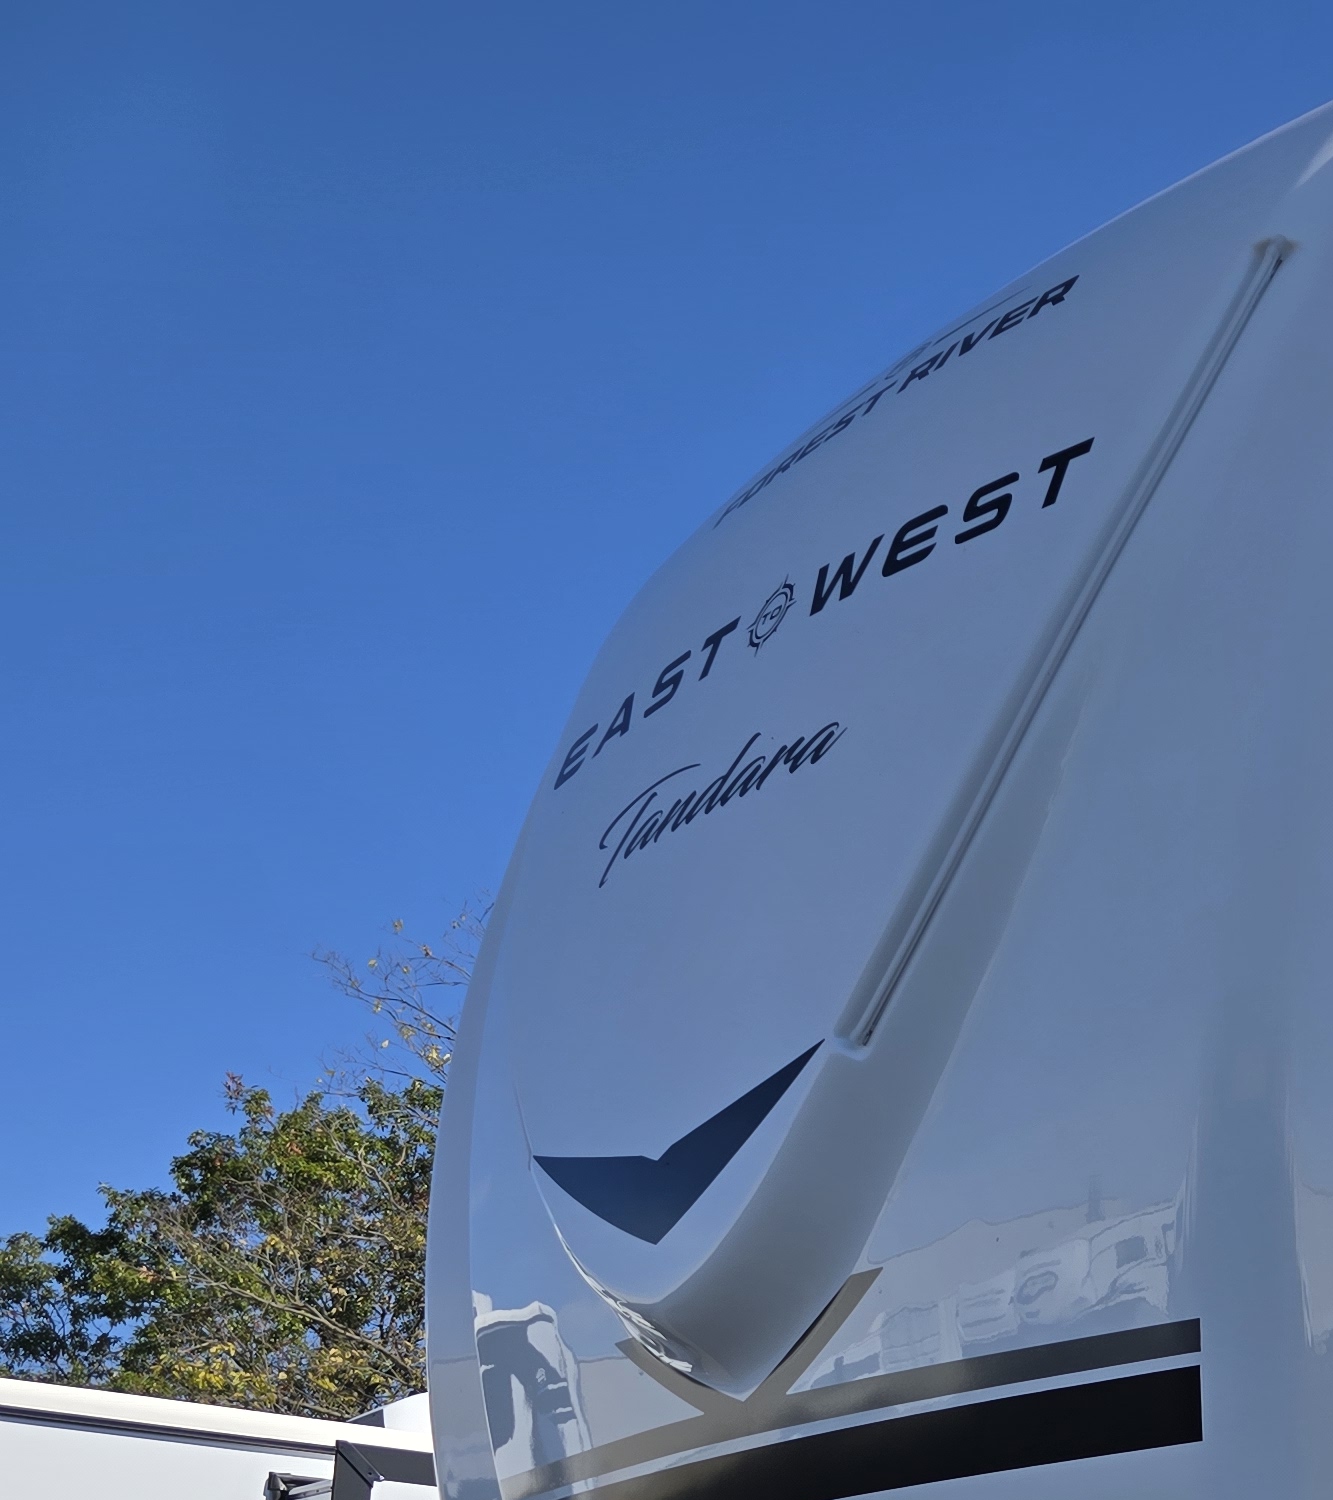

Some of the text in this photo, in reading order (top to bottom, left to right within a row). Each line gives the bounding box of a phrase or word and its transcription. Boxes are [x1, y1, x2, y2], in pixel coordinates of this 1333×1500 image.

[896, 274, 1080, 395] RIVER
[554, 616, 741, 790] EAST
[808, 436, 1095, 617] WEST
[598, 721, 848, 888] Tandara
